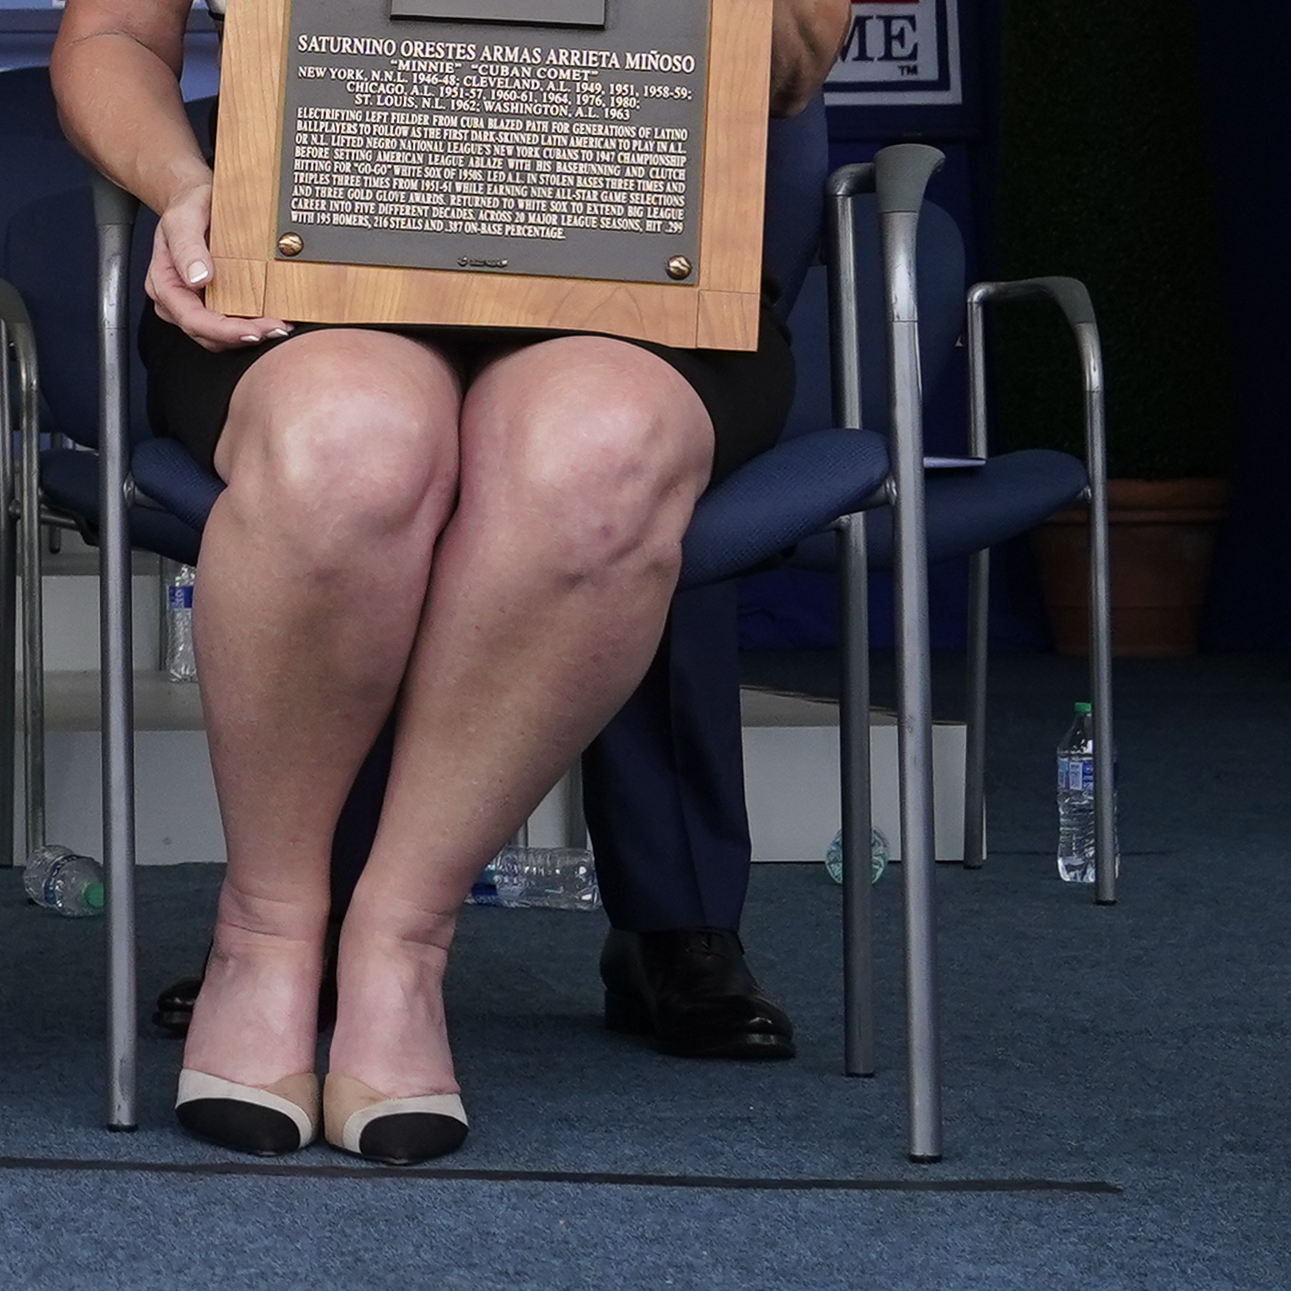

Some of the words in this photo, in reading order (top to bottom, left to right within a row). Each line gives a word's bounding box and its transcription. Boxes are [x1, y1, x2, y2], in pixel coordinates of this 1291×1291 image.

[297, 35, 396, 55] SATURNINO
[400, 40, 476, 60] ORESTES
[479, 45, 541, 63] ARMAS
[545, 48, 620, 67] ARRIETA
[624, 51, 694, 72] MIÑOSO
